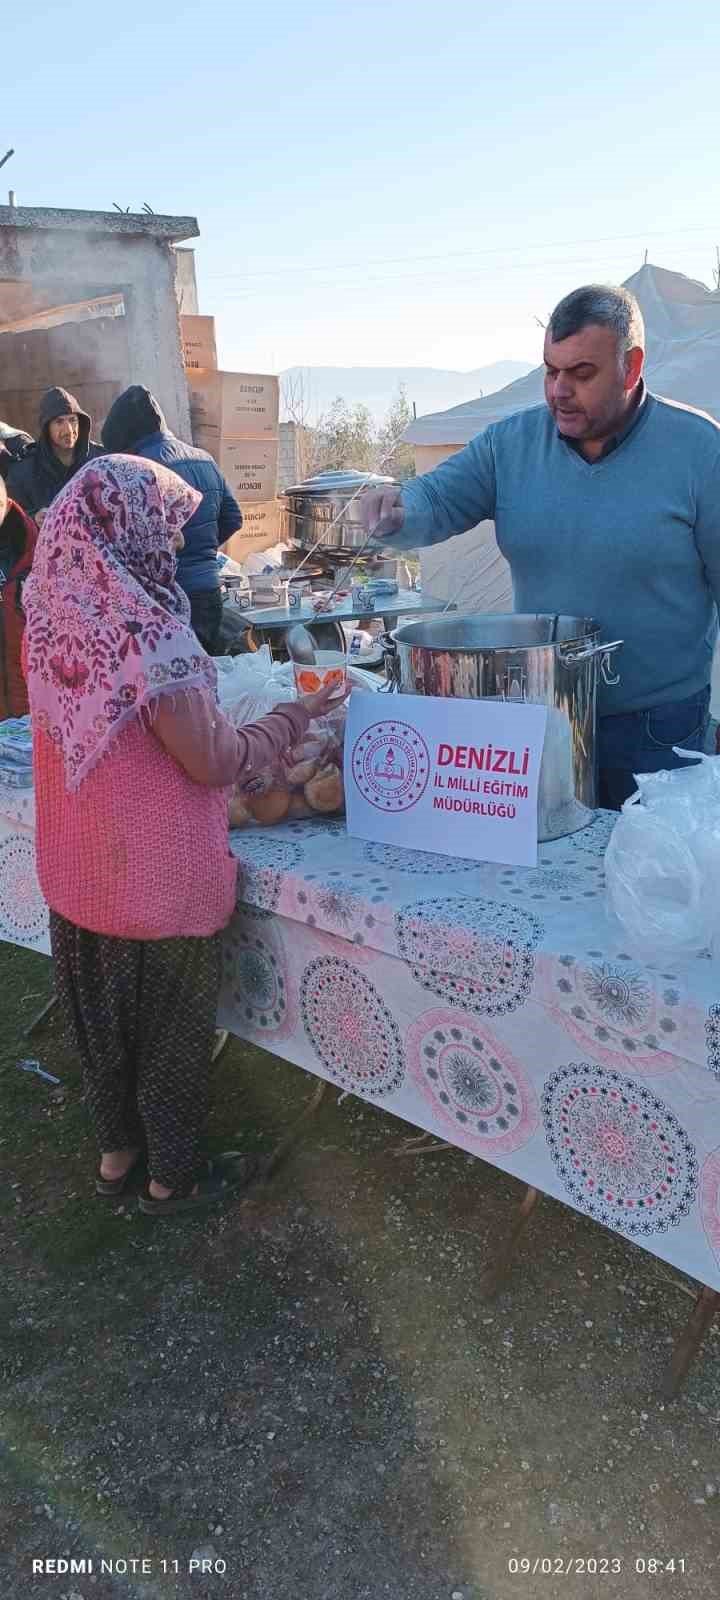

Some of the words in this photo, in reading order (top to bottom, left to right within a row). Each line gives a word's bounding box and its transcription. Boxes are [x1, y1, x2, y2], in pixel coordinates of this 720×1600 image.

[437, 744, 529, 775] DENİZLİ
[434, 772, 444, 788] İL
[447, 775, 480, 793] MİLLİ
[483, 780, 528, 798] EĞİTİM
[433, 796, 516, 818] MÜDÜRLÜĞÜ
